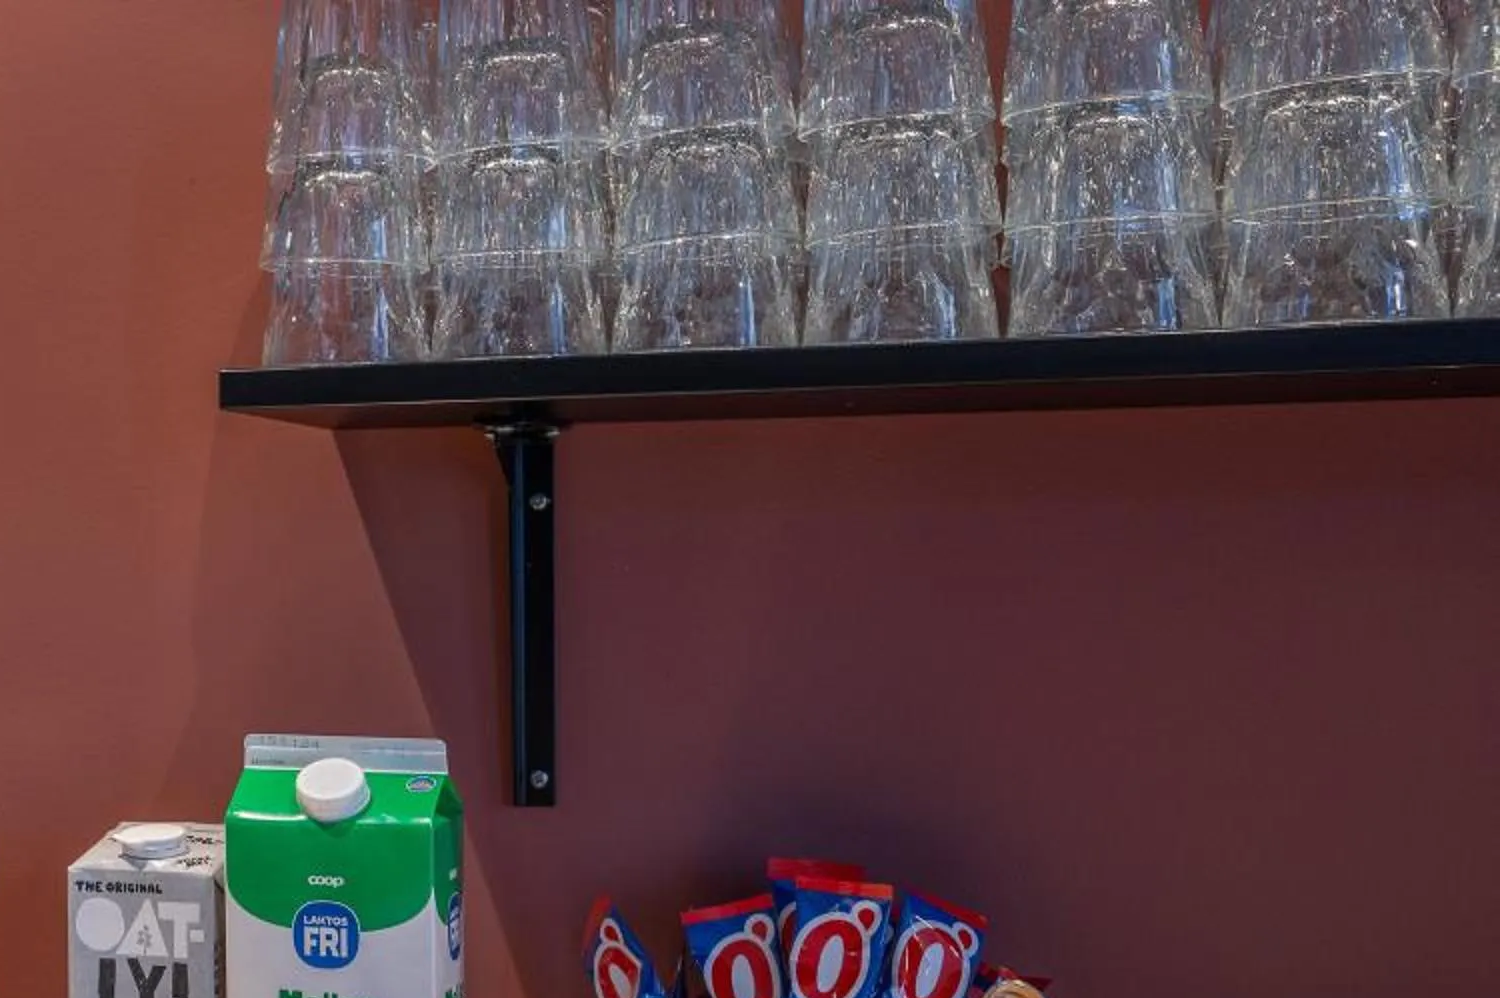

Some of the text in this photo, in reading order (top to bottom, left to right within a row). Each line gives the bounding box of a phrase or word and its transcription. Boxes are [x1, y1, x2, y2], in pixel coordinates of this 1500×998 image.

[75, 881, 163, 894] THE ORIGINAL
[307, 875, 345, 888] coop
[303, 915, 349, 926] LAKTOS
[303, 926, 349, 958] FRI
